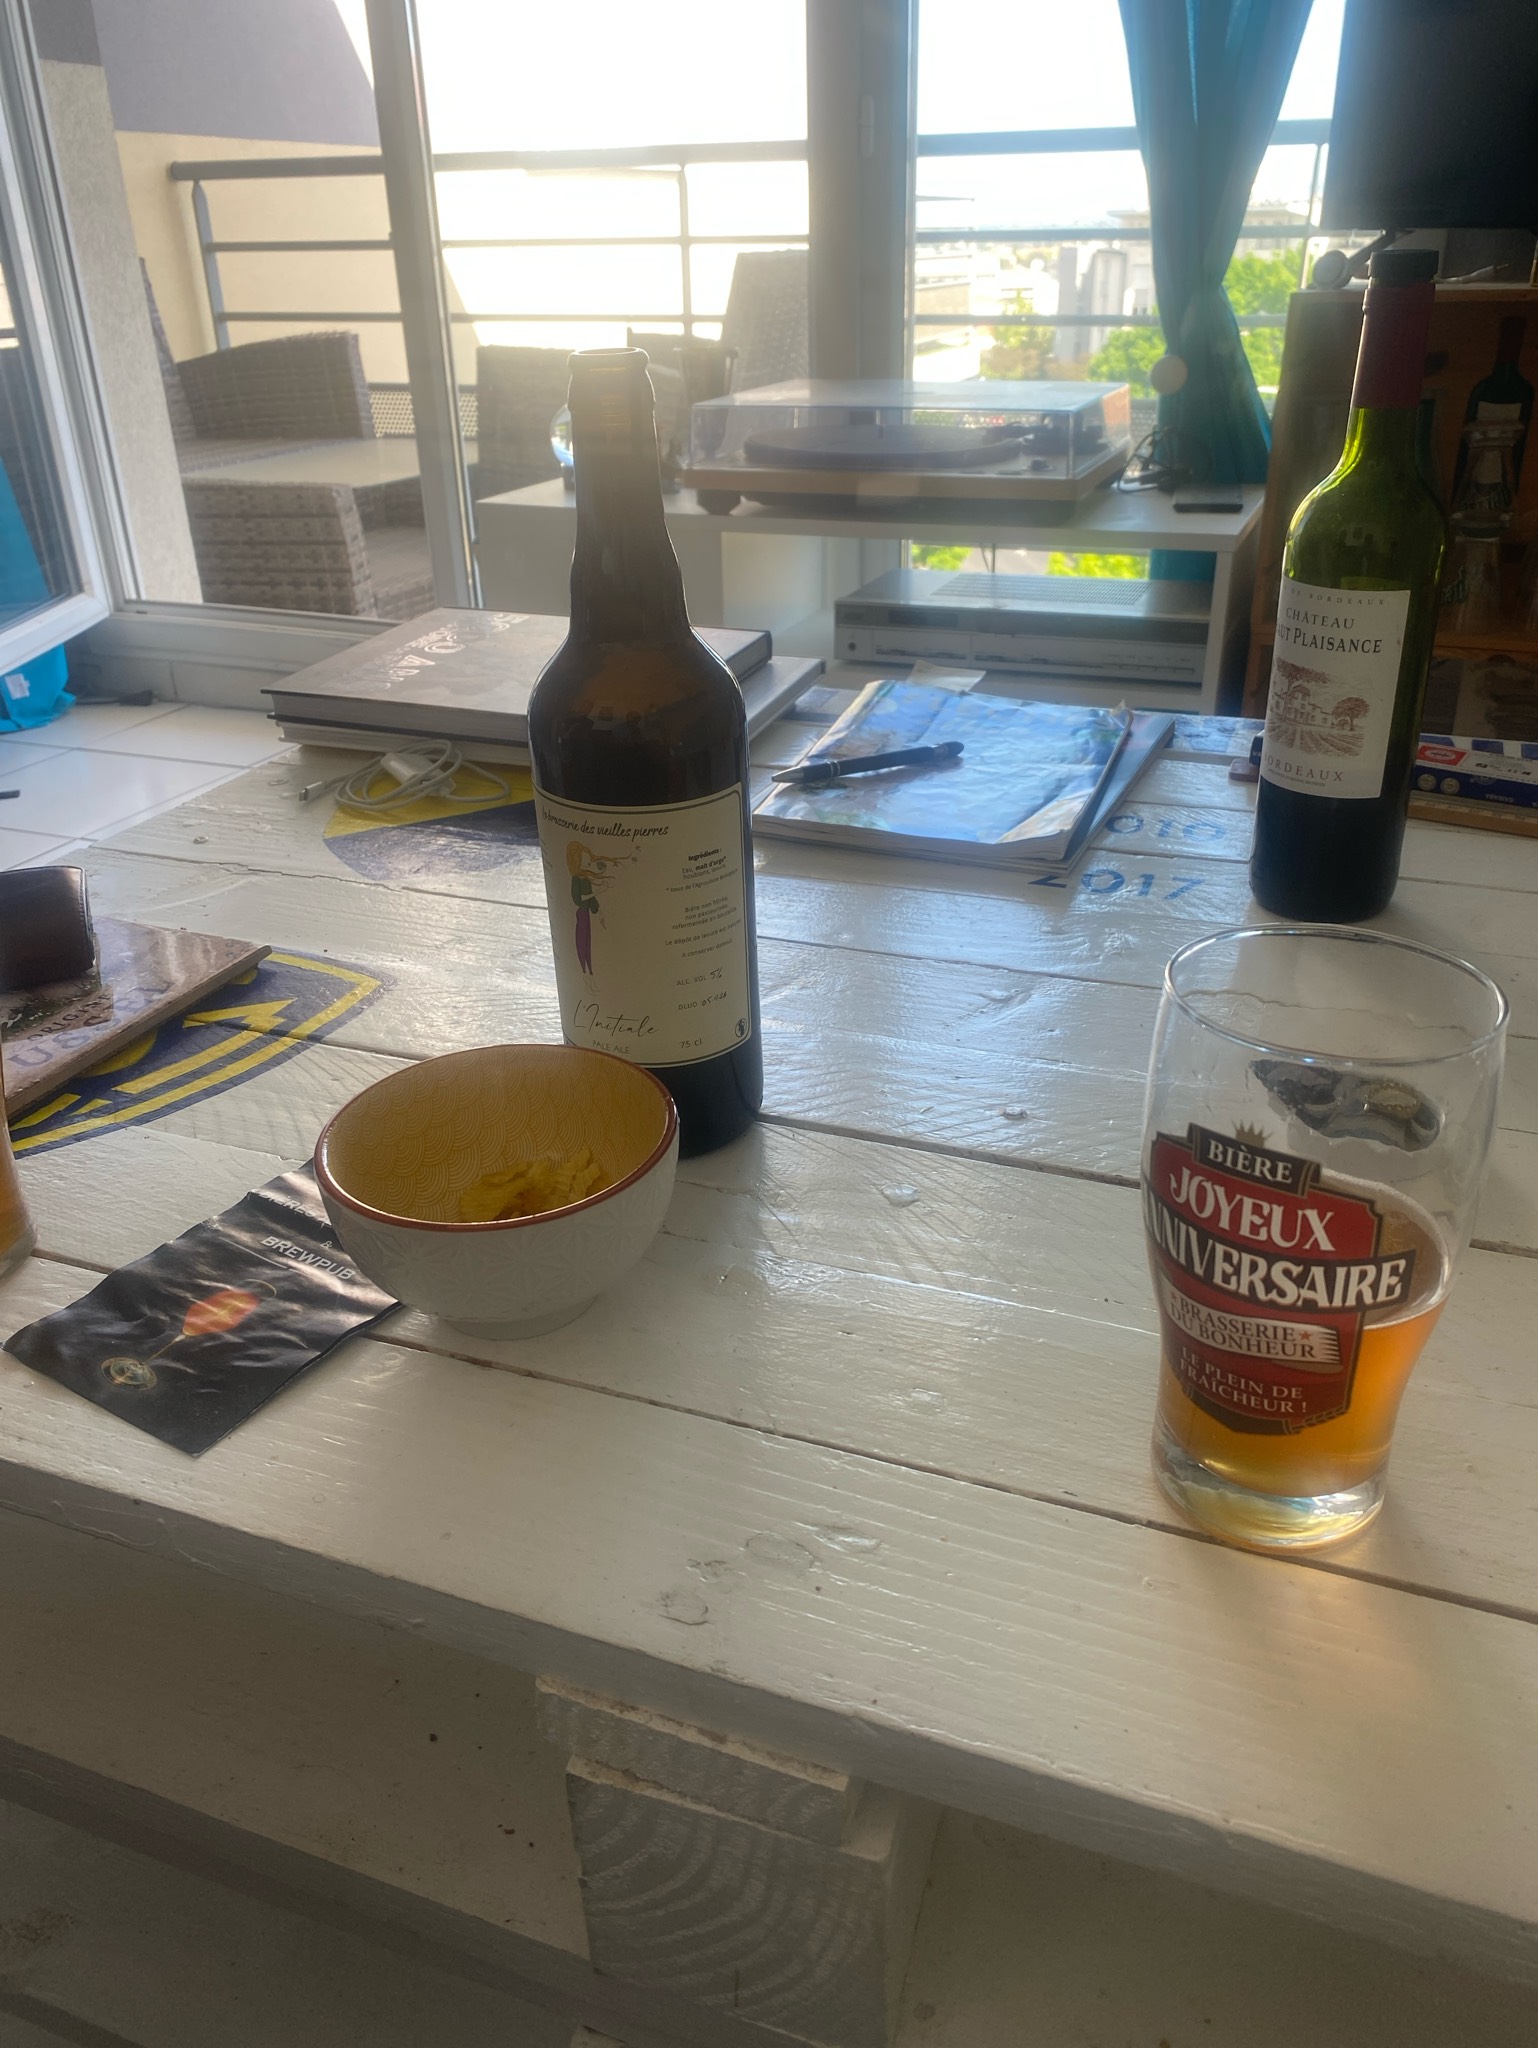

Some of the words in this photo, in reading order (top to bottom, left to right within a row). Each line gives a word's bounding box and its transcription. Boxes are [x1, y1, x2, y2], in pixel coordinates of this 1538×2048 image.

[1286, 607, 1355, 629] CHÂTEAU
[1309, 594, 1384, 606] BORDEAUX
[1293, 628, 1382, 654] PLAISANCE
[548, 809, 579, 832] brasserie
[581, 820, 595, 834] des
[597, 822, 631, 837] vieilles
[632, 825, 669, 842] pierres
[592, 1040, 611, 1052] PALE
[614, 1045, 631, 1054] ALE
[680, 1040, 691, 1048] 75
[1207, 1139, 1293, 1184] BIÈRE
[1169, 1166, 1336, 1251] JOYEUX
[260, 1235, 356, 1280] BREWPUB
[1146, 1188, 1407, 1309] NNIVERSAIRE
[1170, 1303, 1194, 1331] DU
[1200, 1323, 1316, 1358] BONHEUR
[1180, 1297, 1296, 1342] BRASSERIE
[1182, 1347, 1200, 1367] LE
[1205, 1362, 1264, 1395] PLEIN
[1272, 1386, 1303, 1399] DE
